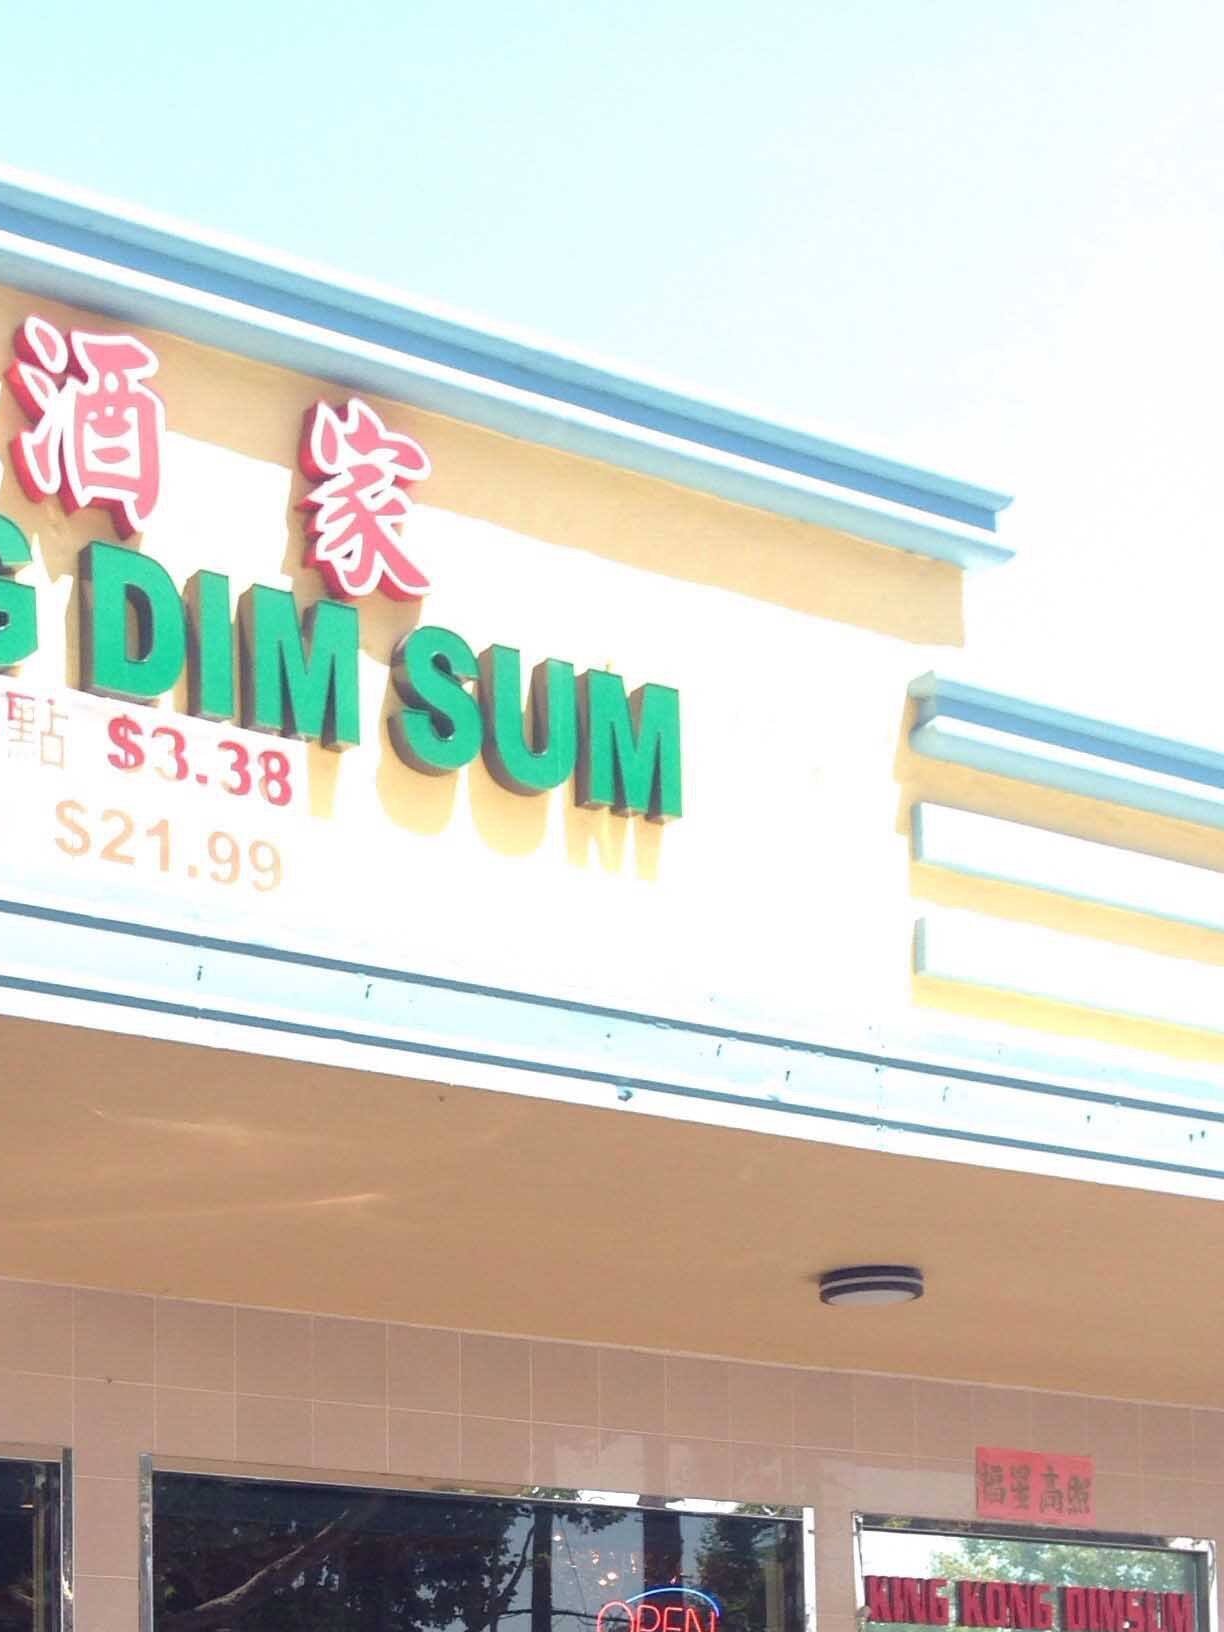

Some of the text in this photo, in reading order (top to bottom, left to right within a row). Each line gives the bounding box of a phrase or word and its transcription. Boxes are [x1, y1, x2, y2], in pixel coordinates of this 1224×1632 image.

[78, 541, 361, 754] DIM
[387, 625, 681, 824] SUM
[106, 714, 294, 806] $3.38
[54, 799, 283, 892] $21.99
[864, 1575, 950, 1626] KING
[955, 1580, 1054, 1631] KONG
